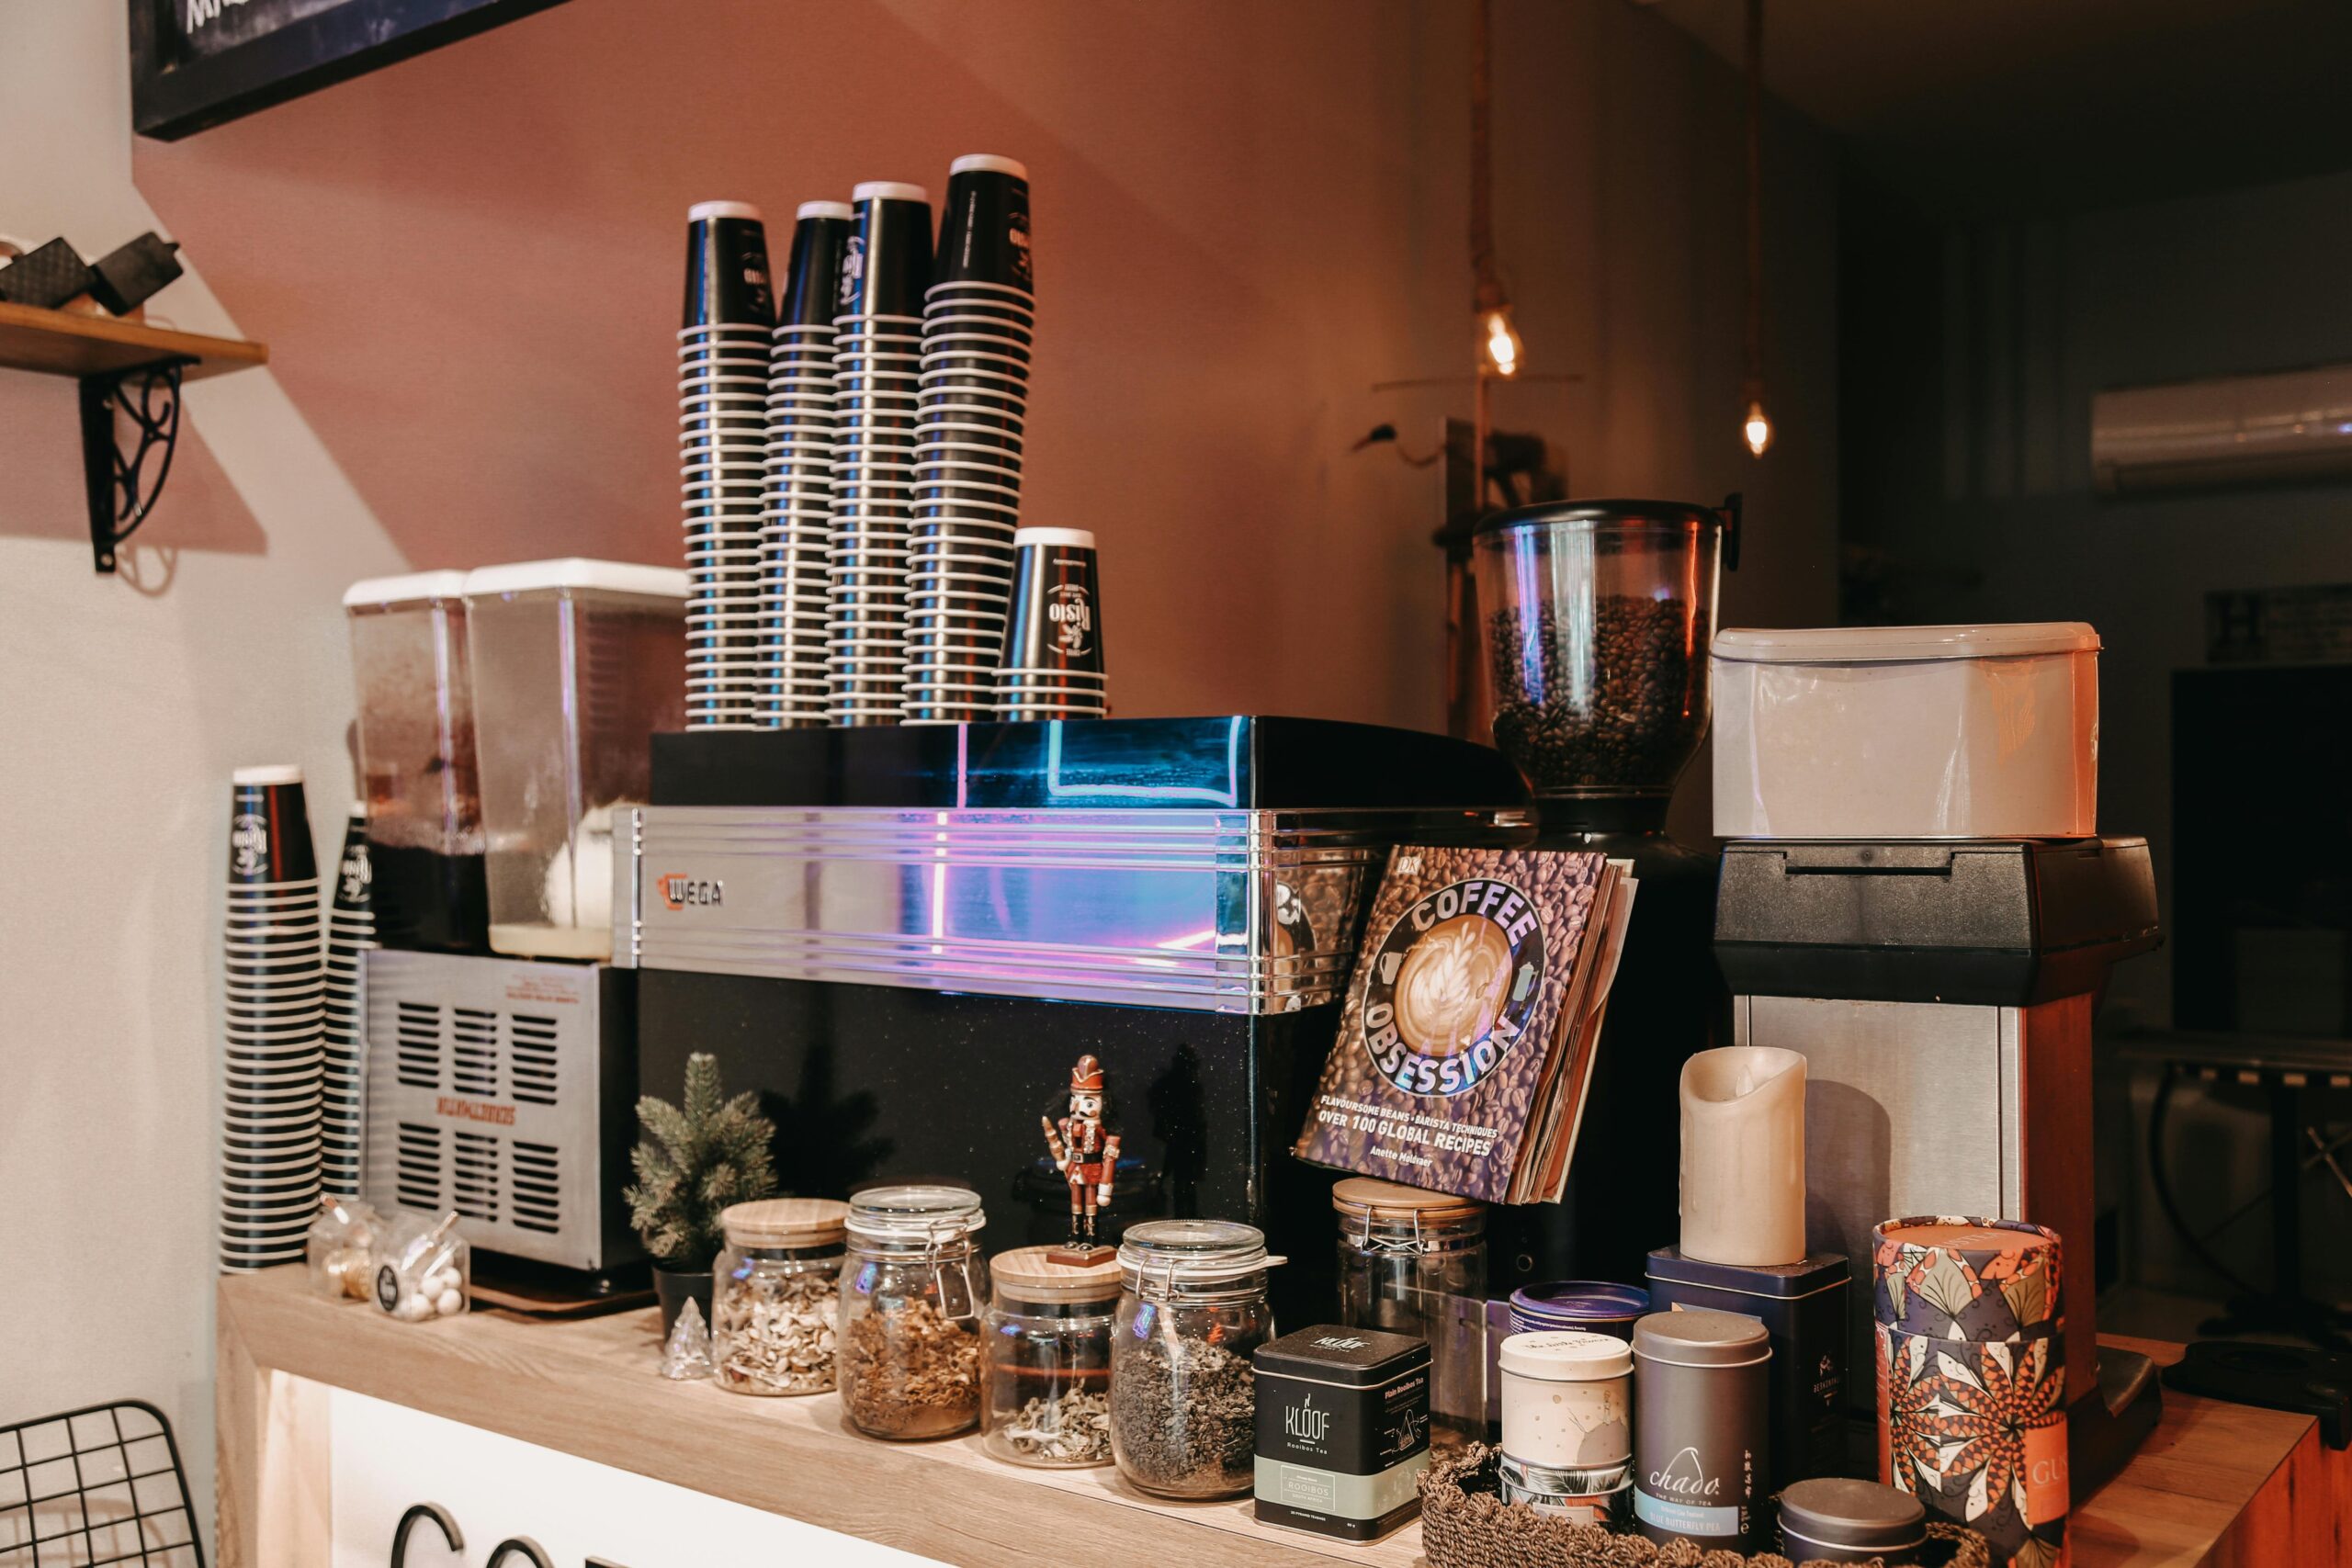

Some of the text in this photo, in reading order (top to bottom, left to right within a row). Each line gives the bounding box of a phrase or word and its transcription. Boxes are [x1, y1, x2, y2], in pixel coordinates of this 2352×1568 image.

[1399, 856, 1421, 873] DK
[668, 878, 723, 907] WEGA
[1411, 882, 1537, 947] COFFEE
[1366, 1002, 1521, 1093] OBSESSION
[1320, 1095, 1498, 1138] FLAVOURSOME BEANS BARISTA TECHNIQUES
[1318, 1110, 1491, 1156] OVER 100 GLOBAL RECIPES
[1370, 1145, 1398, 1159] Anette
[1285, 1405, 1330, 1441] KLOOF
[1287, 1442, 1328, 1455] Rooibos Tea
[1288, 1481, 1329, 1496] ROOIBOS
[1656, 1493, 1668, 1501] THE
[1669, 1496, 1683, 1505] WAY
[1649, 1512, 1664, 1525] BLUE
[1665, 1517, 1705, 1531] BUTTERFLY
[1706, 1521, 1721, 1532] PEA
